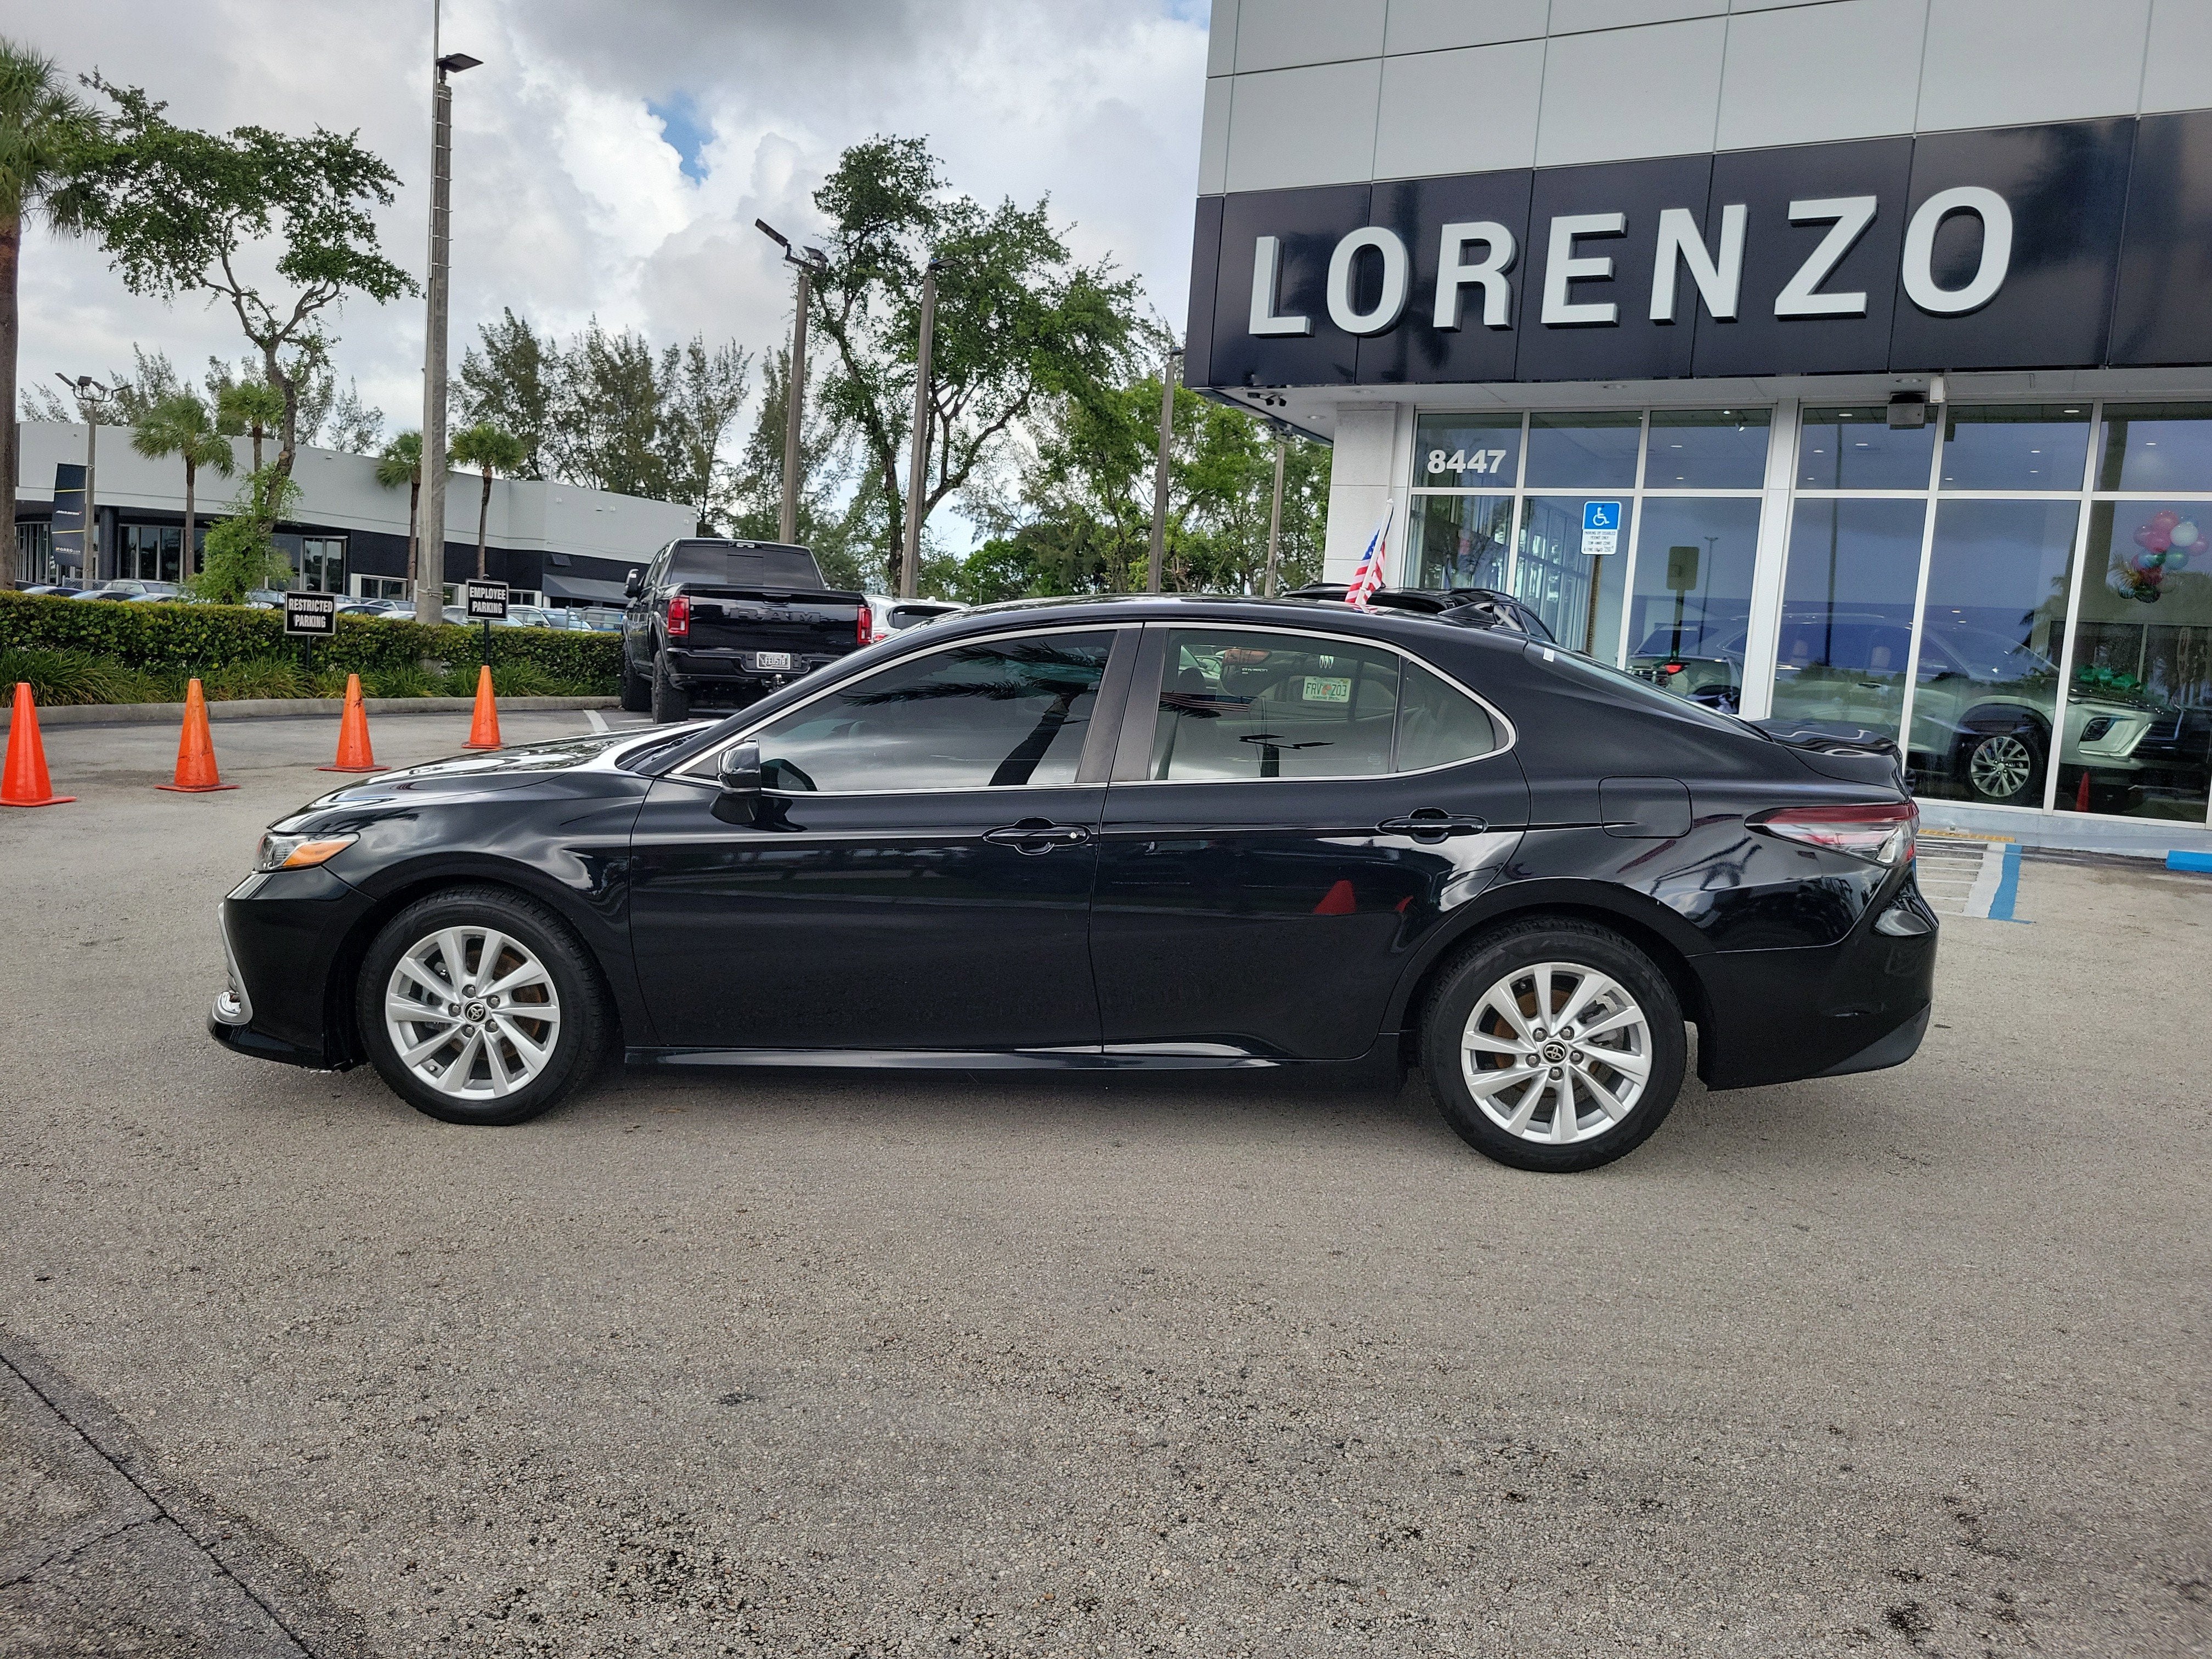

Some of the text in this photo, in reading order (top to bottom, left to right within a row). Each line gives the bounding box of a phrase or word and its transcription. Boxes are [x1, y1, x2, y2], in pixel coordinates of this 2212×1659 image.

[1248, 187, 2013, 337] LORENZO
[1427, 449, 1506, 474] 8447
[469, 586, 506, 600] EMPLOYEE
[288, 597, 334, 613] RESTRICTED
[472, 602, 503, 614] PARKING
[294, 614, 326, 628] PARKING
[730, 607, 821, 623] RAM
[1305, 682, 1323, 695] FRV
